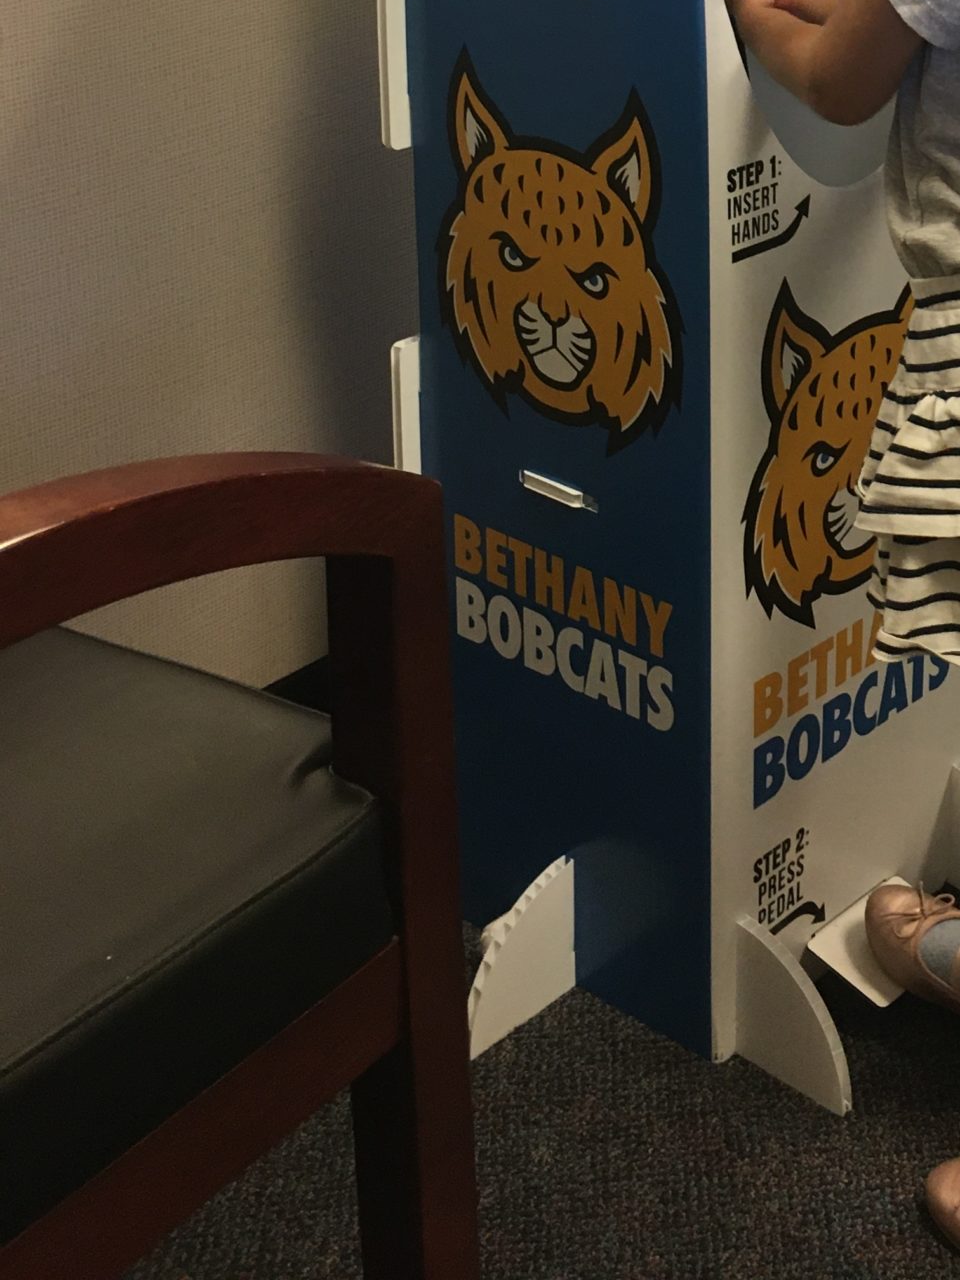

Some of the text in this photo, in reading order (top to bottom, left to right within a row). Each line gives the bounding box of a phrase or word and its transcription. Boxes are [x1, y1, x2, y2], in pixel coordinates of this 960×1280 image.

[727, 155, 782, 193] STEP 1:
[727, 182, 779, 220] INSERT
[731, 209, 780, 246] HANDS
[454, 513, 673, 658] BETHANY
[456, 575, 675, 732] BOBCATS
[753, 611, 885, 739] BETH
[753, 655, 950, 811] BOBCATS
[753, 827, 810, 884] STEP 2:
[758, 854, 804, 907] PRESS
[758, 881, 804, 925] PEDAL
